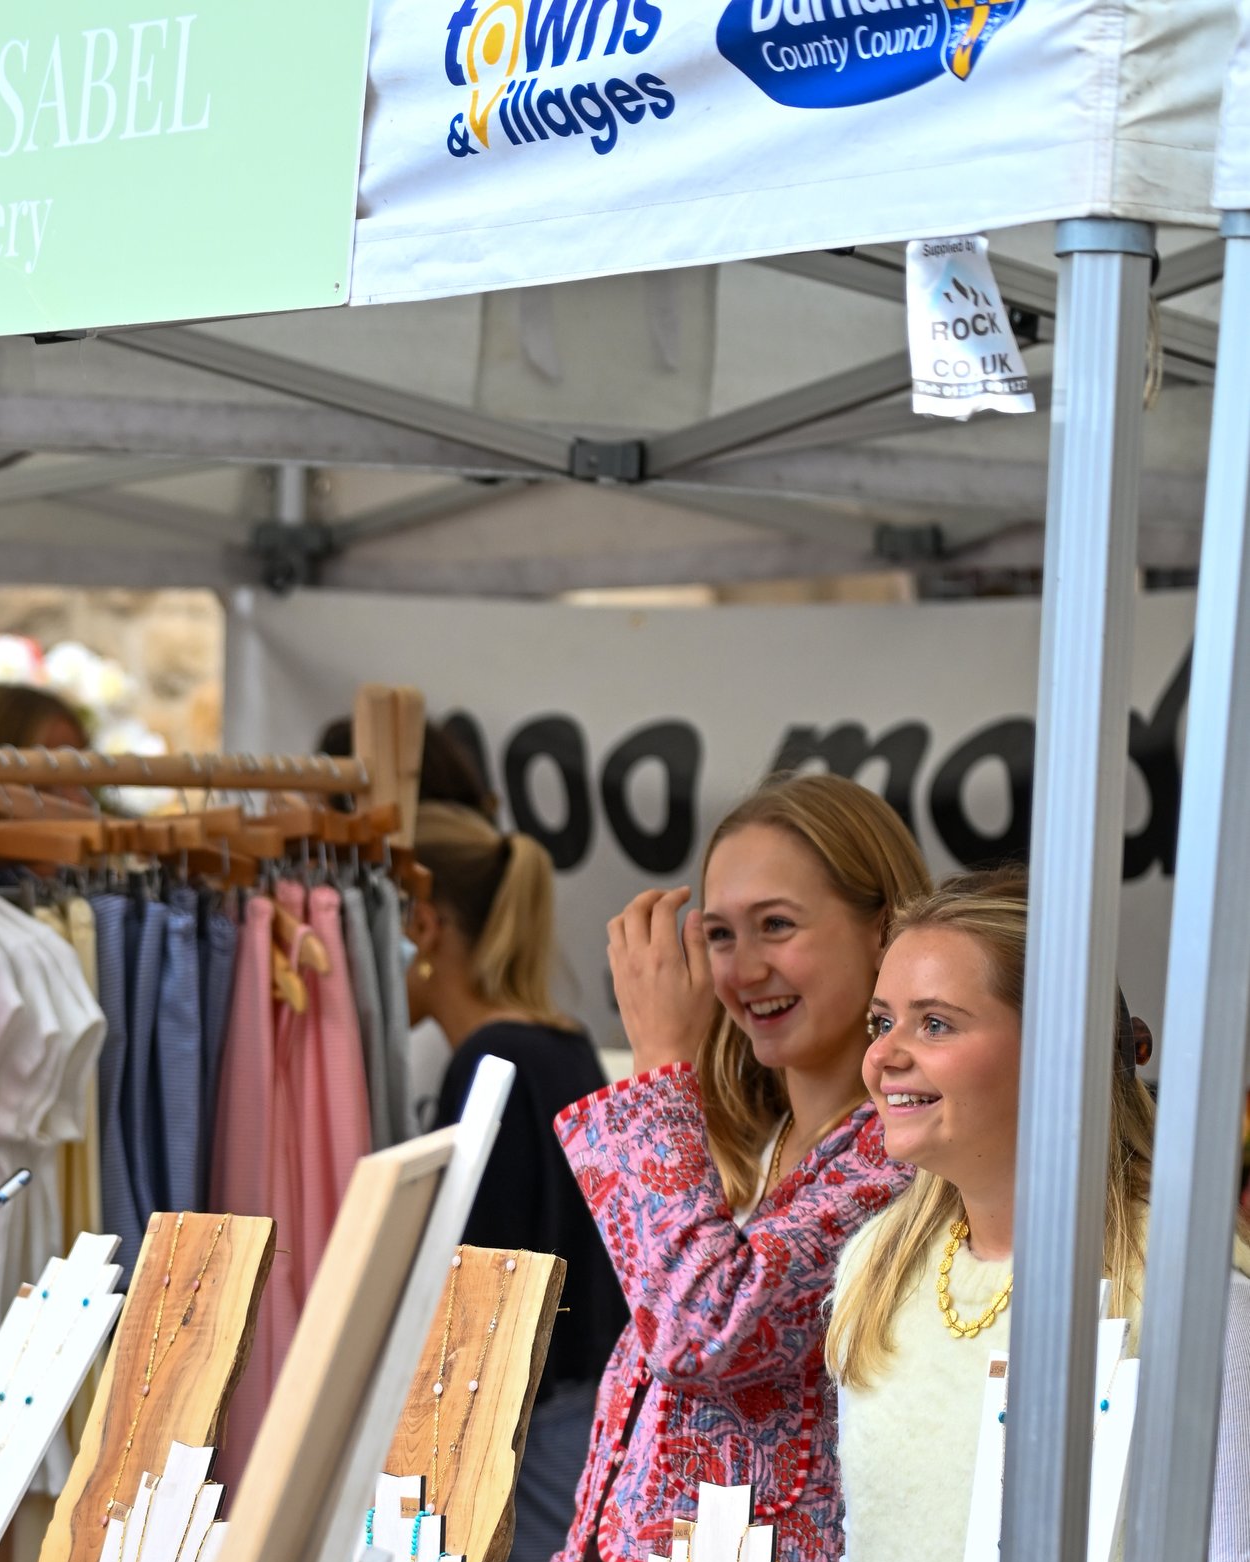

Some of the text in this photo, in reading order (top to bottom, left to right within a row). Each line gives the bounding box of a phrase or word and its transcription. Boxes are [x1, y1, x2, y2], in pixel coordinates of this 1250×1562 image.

[445, 0, 662, 86] towns
[761, 13, 938, 72] County Council
[931, 312, 1002, 341] ROCK
[445, 705, 702, 877] oo
